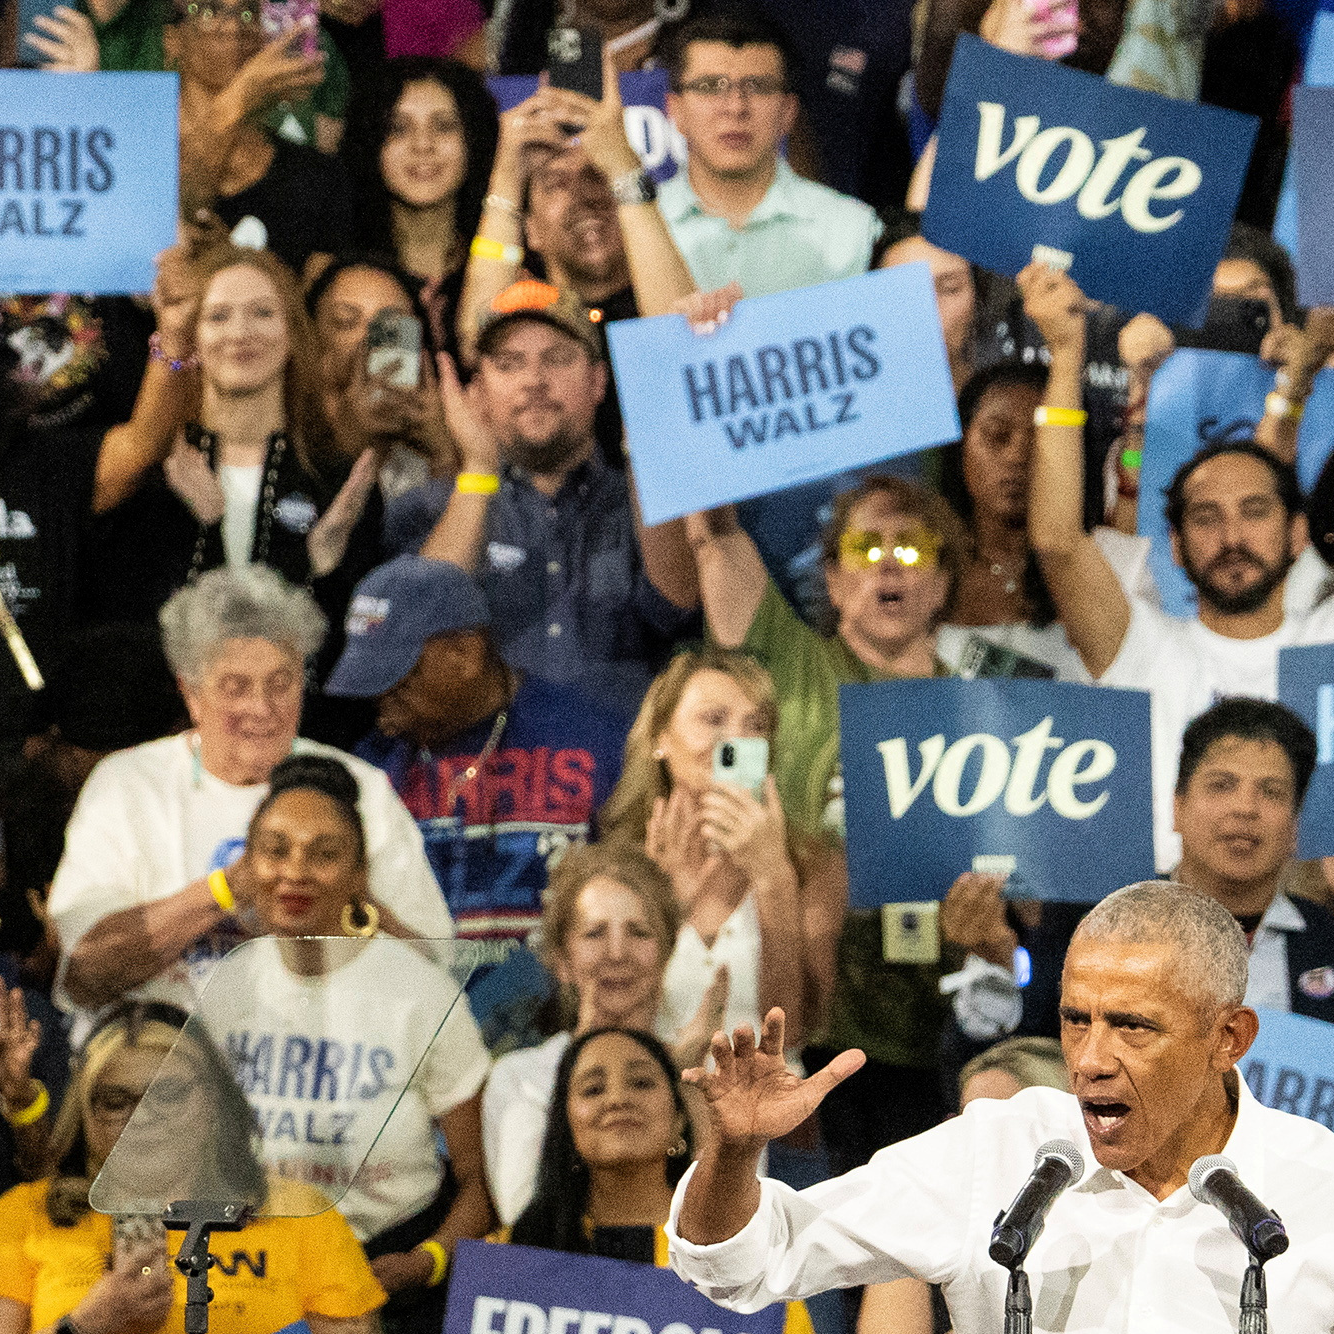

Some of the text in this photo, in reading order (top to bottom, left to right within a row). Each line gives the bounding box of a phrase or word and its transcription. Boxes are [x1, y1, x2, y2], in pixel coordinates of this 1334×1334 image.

[975, 101, 1202, 233] vote
[684, 325, 881, 422] HARRIS
[724, 394, 858, 452] WALZ
[878, 716, 1117, 820] vote
